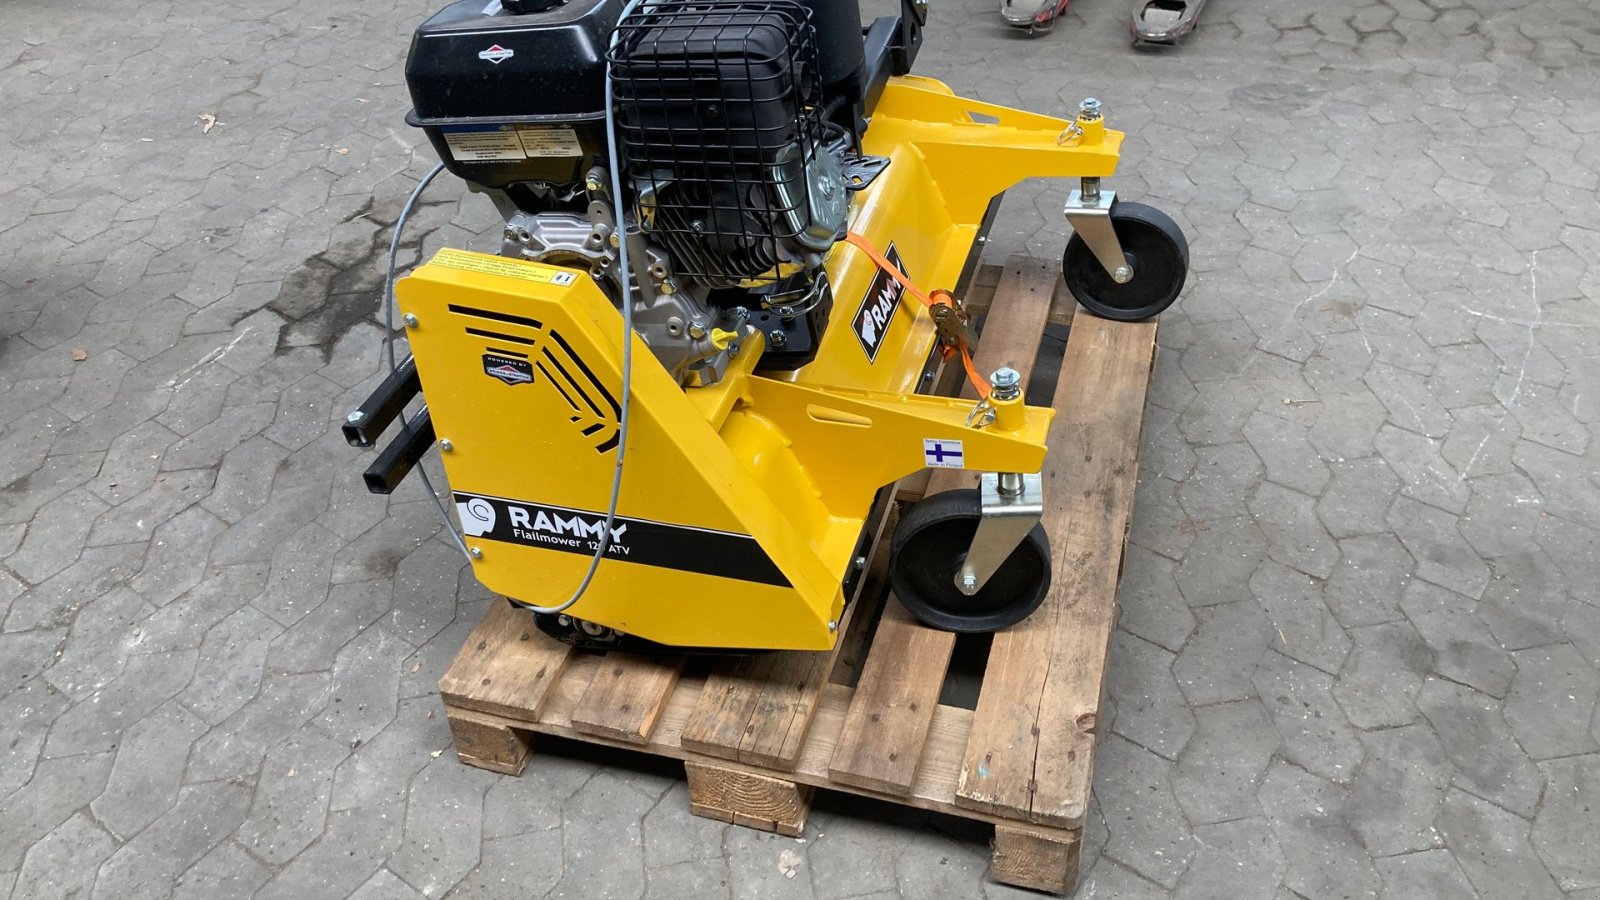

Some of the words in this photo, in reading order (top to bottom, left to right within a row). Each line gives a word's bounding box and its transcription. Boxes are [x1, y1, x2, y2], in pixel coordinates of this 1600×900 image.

[871, 258, 902, 331] RAMM
[487, 357, 517, 365] POWERED
[507, 506, 627, 543] RAMMY
[513, 528, 581, 548] Flailmower
[608, 544, 631, 555] ATV
